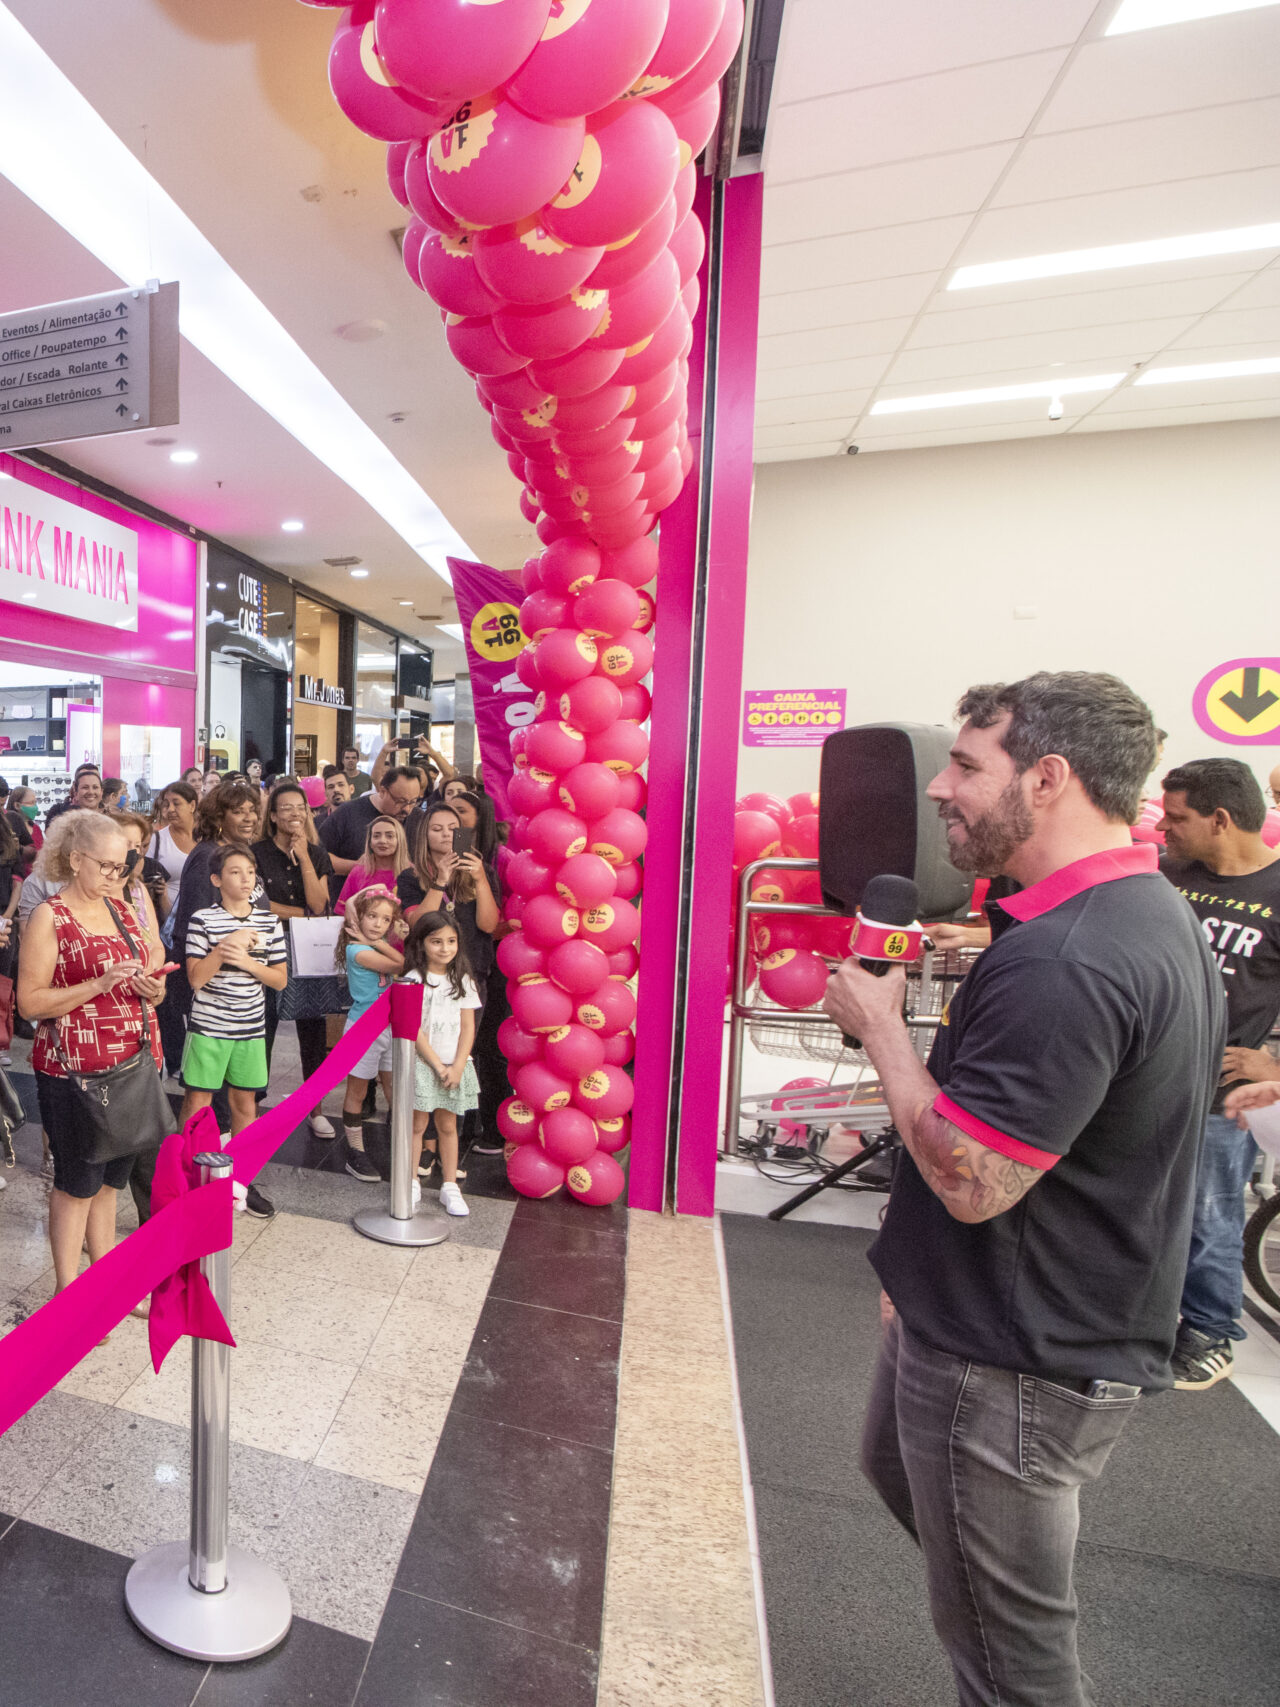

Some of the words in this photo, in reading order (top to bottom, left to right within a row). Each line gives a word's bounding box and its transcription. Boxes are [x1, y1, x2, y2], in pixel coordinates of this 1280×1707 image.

[2, 323, 39, 340] Eventos
[49, 308, 112, 329] Alimentação
[2, 348, 31, 363] Office
[41, 334, 107, 355] Poupatempo
[27, 368, 61, 382] Escada
[68, 360, 108, 375] Rolante
[12, 394, 43, 409] Caixas
[45, 386, 102, 404] Eletrônicos
[53, 525, 129, 605] MANIA
[238, 572, 258, 607] CUTE
[238, 607, 258, 638] CASE
[481, 616, 504, 648] 1A
[499, 613, 521, 646] 99
[748, 701, 842, 711] PREFERENCIAL
[773, 692, 817, 702] CAIXA
[887, 944, 903, 954] 99
[889, 935, 905, 945] 1A
